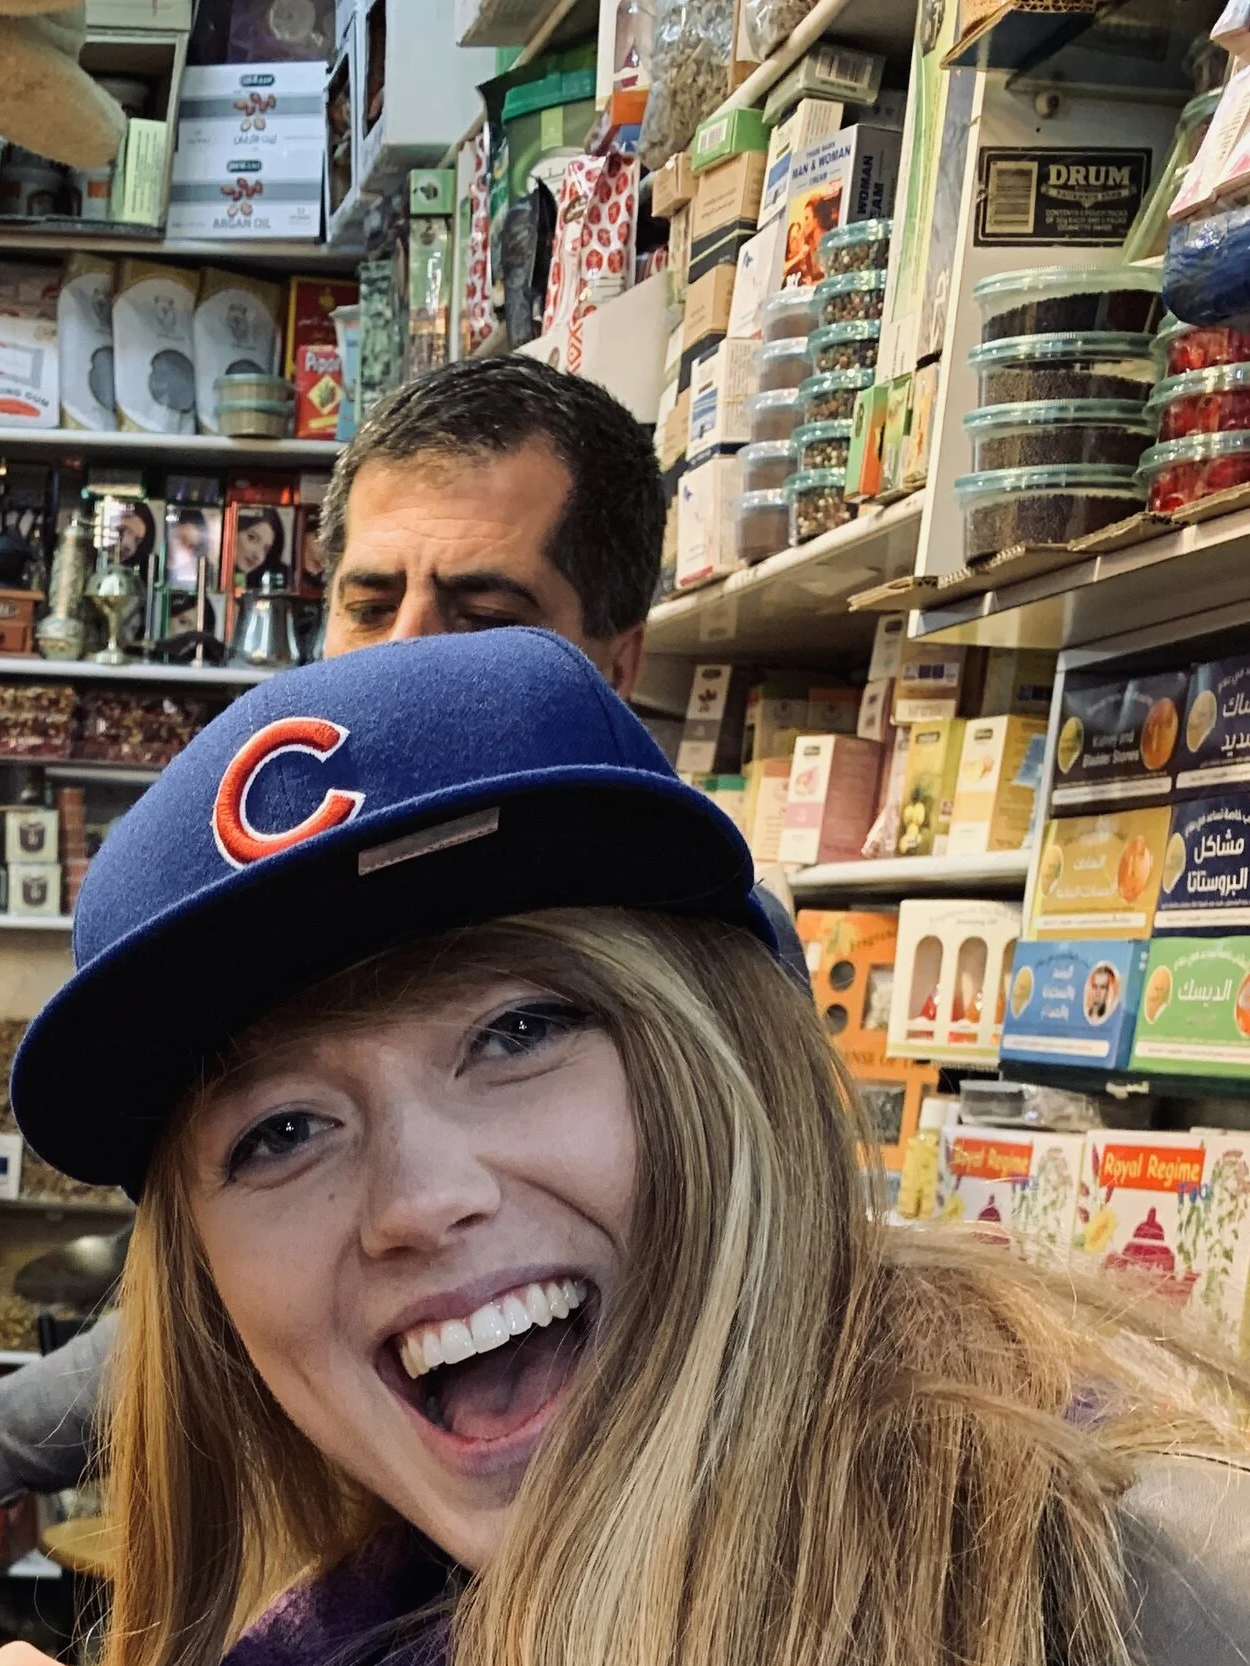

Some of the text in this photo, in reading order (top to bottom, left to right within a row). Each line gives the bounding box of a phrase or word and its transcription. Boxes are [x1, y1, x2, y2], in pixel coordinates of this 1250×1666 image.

[792, 165, 809, 180] MAN
[818, 147, 852, 167] WOMAN
[1047, 164, 1132, 186] DRUM
[857, 155, 874, 214] WOMAN
[213, 217, 271, 229] ARGAN OIL
[212, 716, 366, 870] C
[1194, 828, 1245, 864] مشاكل
[1187, 866, 1249, 897] البروستاتا
[1178, 977, 1233, 1008] الديسك
[1103, 1153, 1200, 1187] Royal Regime
